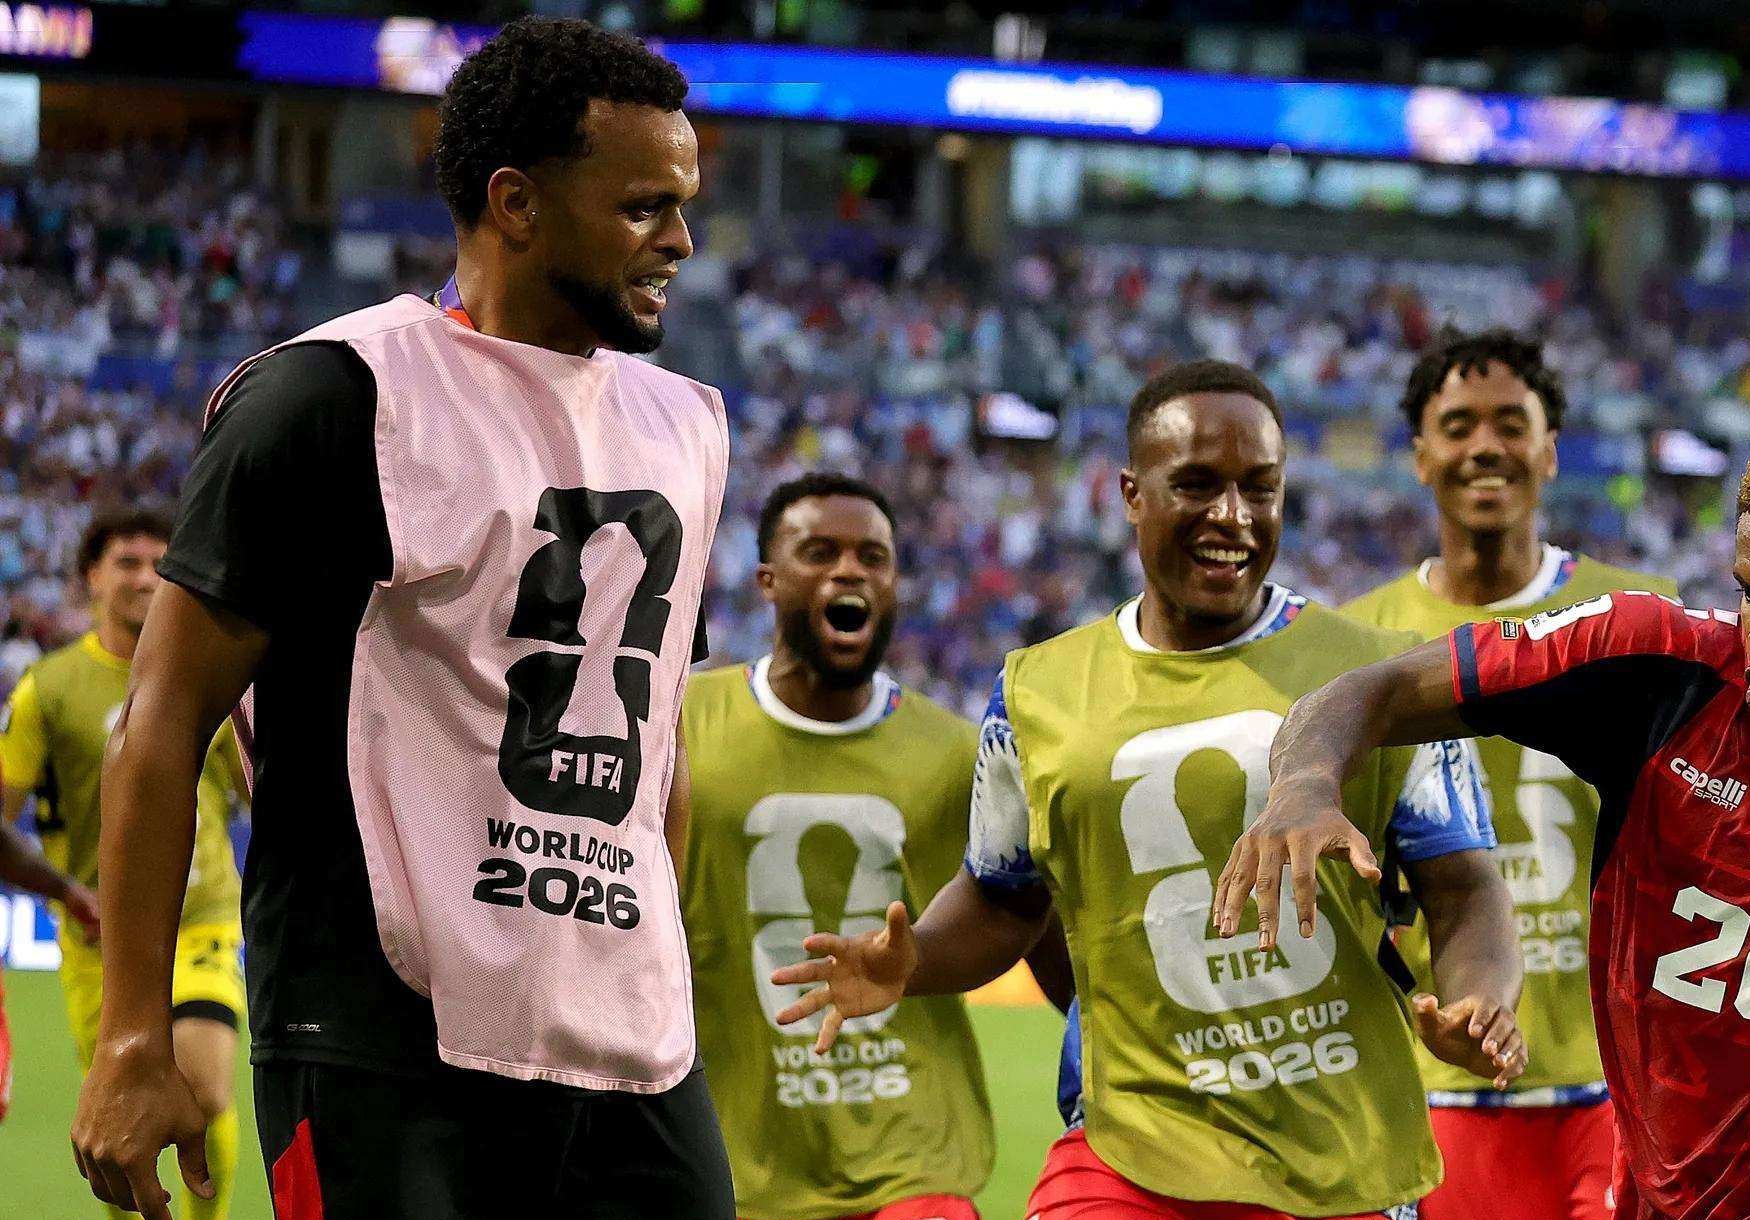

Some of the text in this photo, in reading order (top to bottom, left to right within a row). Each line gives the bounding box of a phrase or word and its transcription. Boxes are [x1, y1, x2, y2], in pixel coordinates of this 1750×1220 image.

[549, 750, 624, 793] FIFA
[1670, 757, 1748, 805] capelli
[1694, 788, 1738, 812] SPORT
[486, 817, 635, 875] WORLD CUP
[1501, 856, 1544, 880] IFA
[472, 857, 641, 931] 2026
[1206, 946, 1292, 985] FIFA
[1523, 936, 1587, 975] 26
[1175, 999, 1350, 1057] WORLD CUP
[775, 1063, 912, 1109] 2026
[1186, 1030, 1360, 1097] 2026
